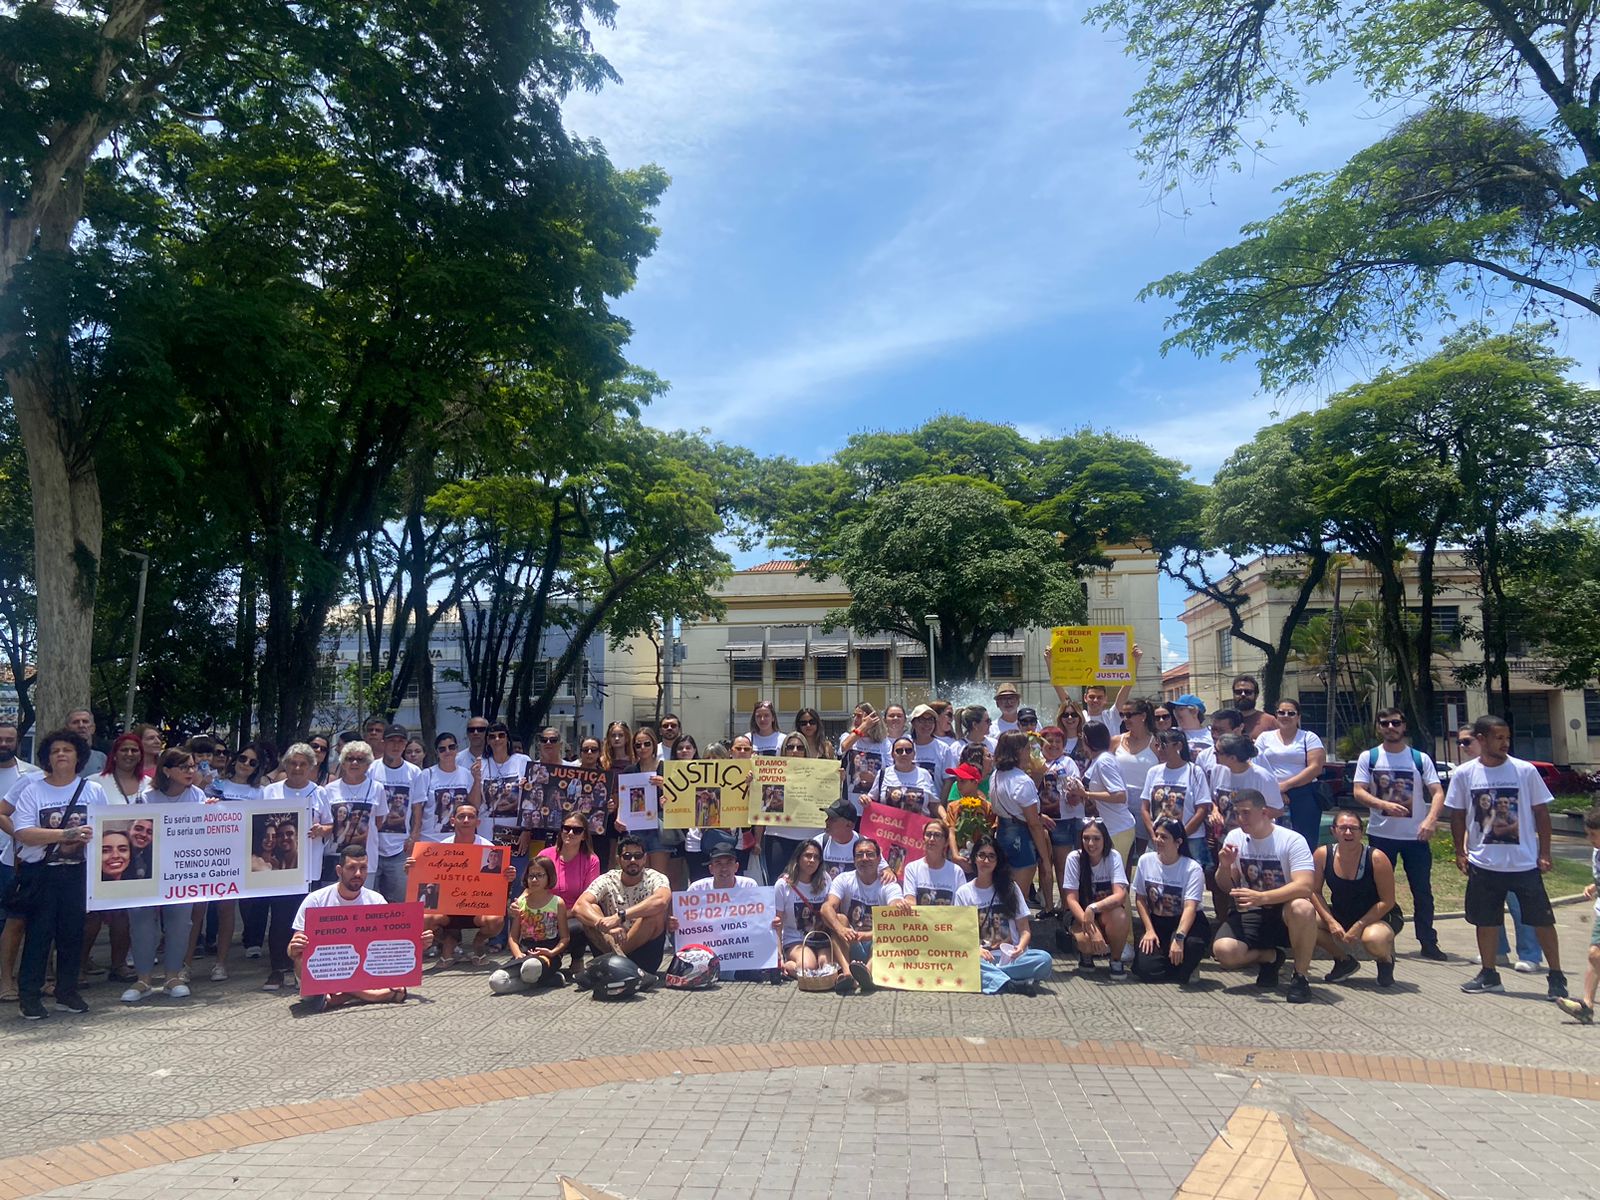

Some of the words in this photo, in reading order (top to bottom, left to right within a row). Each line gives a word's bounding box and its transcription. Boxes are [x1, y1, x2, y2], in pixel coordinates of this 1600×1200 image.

[1096, 672, 1130, 680] JUSTIÇA
[550, 768, 607, 784] JUSTIÇA
[757, 775, 787, 783] JOVENS
[663, 762, 749, 802] JUSTIÇA
[164, 815, 172, 824] Eu
[174, 815, 190, 824] seria
[204, 812, 242, 822] ADVOGADO
[869, 813, 905, 829] CASAL
[167, 828, 175, 836] Eu
[177, 827, 193, 836] seria
[207, 825, 239, 834] DENTISTA
[174, 849, 202, 858] NOSSO
[203, 848, 231, 856] SONHO
[423, 847, 438, 857] Eu
[175, 859, 210, 869] TEMINOU
[211, 858, 230, 867] AQUI
[164, 872, 199, 881] Laryssa
[209, 868, 240, 878] Gabriel
[434, 873, 480, 882] JUSTIÇA
[165, 882, 239, 899] JUSTIÇA
[451, 887, 467, 897] Eu
[679, 895, 700, 907] NO
[706, 892, 731, 905] DIA
[319, 914, 348, 922] BEBIDA
[365, 911, 405, 920] DIREÇÃO:
[684, 902, 765, 921] 15/02/2020
[881, 910, 920, 918] GABRIEL
[315, 928, 347, 936] PERIGO
[384, 923, 411, 931] TODOS
[679, 925, 714, 935] NOSSAS
[721, 921, 748, 931] VIDAS
[877, 923, 896, 931] ERA
[903, 923, 928, 931] PARA
[934, 924, 953, 932] SER
[703, 936, 750, 948] MUDARAM
[876, 934, 929, 944] ADVOGADO
[719, 951, 754, 961] SEMPRE
[876, 949, 920, 958] LUTANDO
[927, 949, 969, 958] CONTRA
[903, 962, 954, 972] INJUSTIÇA
